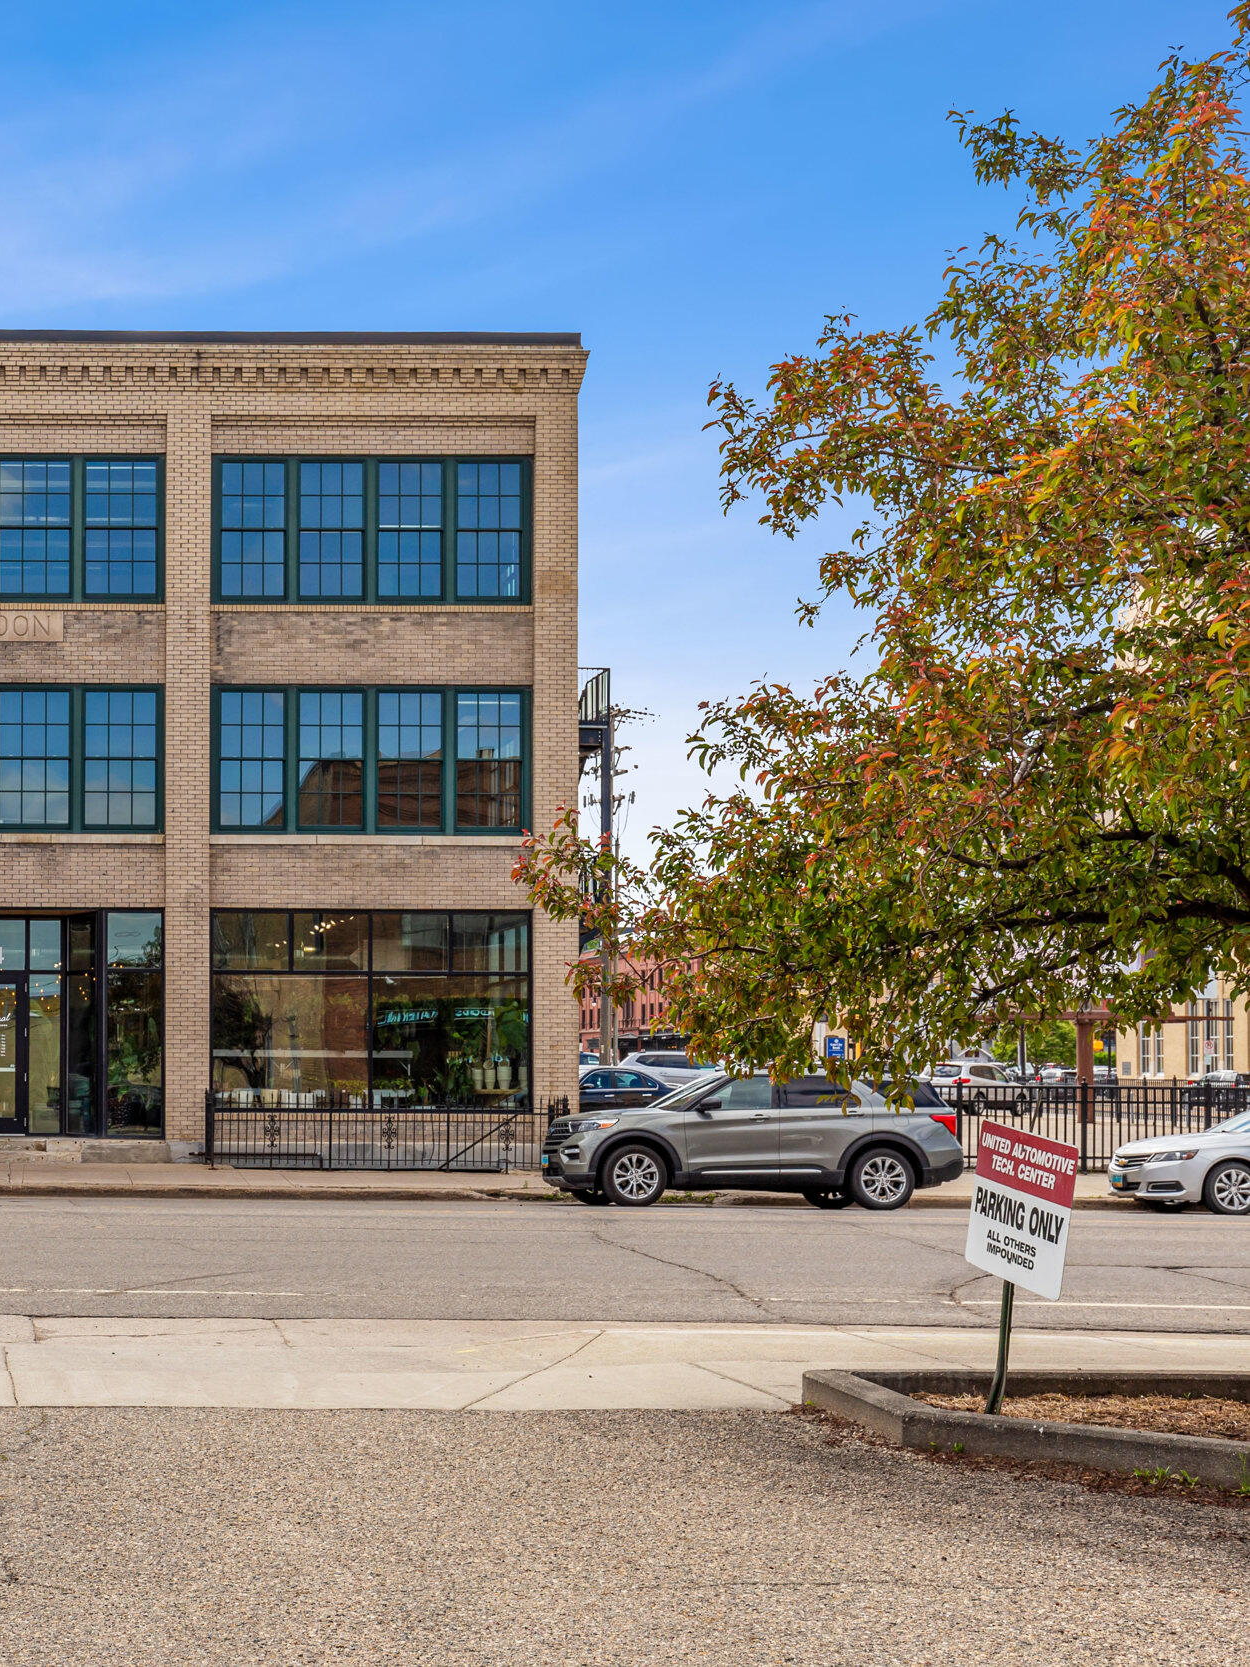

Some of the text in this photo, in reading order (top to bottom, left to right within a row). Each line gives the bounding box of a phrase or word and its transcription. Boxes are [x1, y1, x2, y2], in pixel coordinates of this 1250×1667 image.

[981, 1131, 1076, 1176] UNITED AUTOMOTIVE
[991, 1154, 1056, 1190] TECH. CENTER
[974, 1185, 1065, 1245] PARKING ONLY
[986, 1229, 1037, 1258] ALL OTHERS
[986, 1242, 1035, 1271] IMPOUNDED
